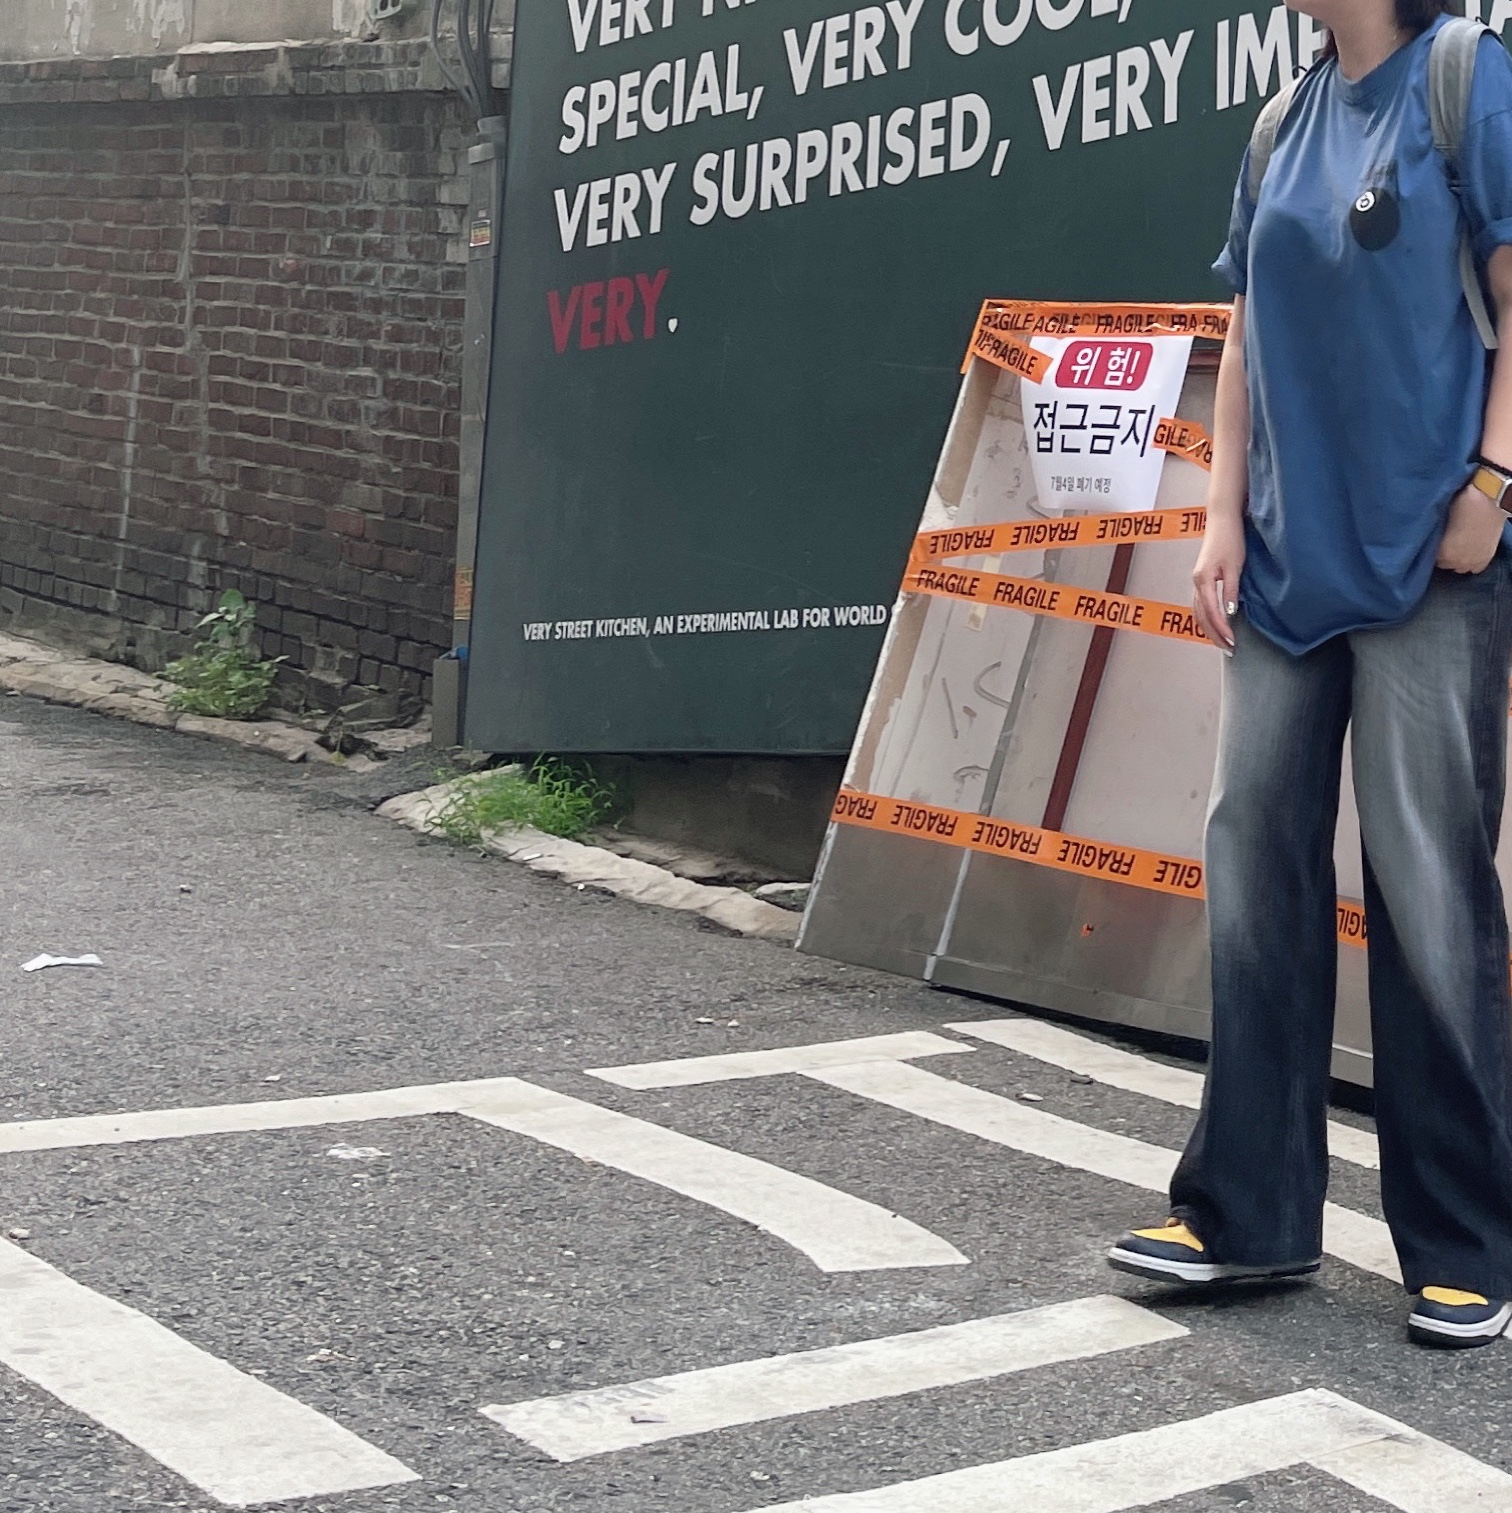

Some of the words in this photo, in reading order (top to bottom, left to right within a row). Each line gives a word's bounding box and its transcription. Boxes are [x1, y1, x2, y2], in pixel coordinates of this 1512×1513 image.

[558, 45, 765, 156] SPECIAL,
[553, 163, 675, 253] VERY
[690, 92, 1011, 229] SURPRISED,
[1032, 29, 1193, 151] VERY
[546, 267, 680, 355] VERY.
[1032, 400, 1156, 458] 접근금지
[1153, 423, 1190, 448] GILE
[929, 528, 995, 555] FRAGILE
[1009, 520, 1080, 547] FRAGILE
[1095, 514, 1164, 540] FRAGILE
[523, 621, 552, 641] VERY
[554, 619, 593, 640] STREET
[595, 617, 651, 639] KITCHEN,
[653, 615, 674, 635] AN
[677, 610, 771, 634] EXPERIMENTAL
[773, 608, 800, 630] LAB
[802, 606, 830, 628] FOR
[833, 604, 887, 627] WORLD
[916, 569, 981, 598] FRAGILE
[992, 580, 1061, 612] FRAGILE
[1073, 594, 1145, 627] FRAGILE
[890, 803, 959, 838] FRAGILE
[971, 820, 1044, 856] FRAGILE
[1056, 839, 1137, 876] FRAGILE
[1152, 858, 1202, 890] GILE
